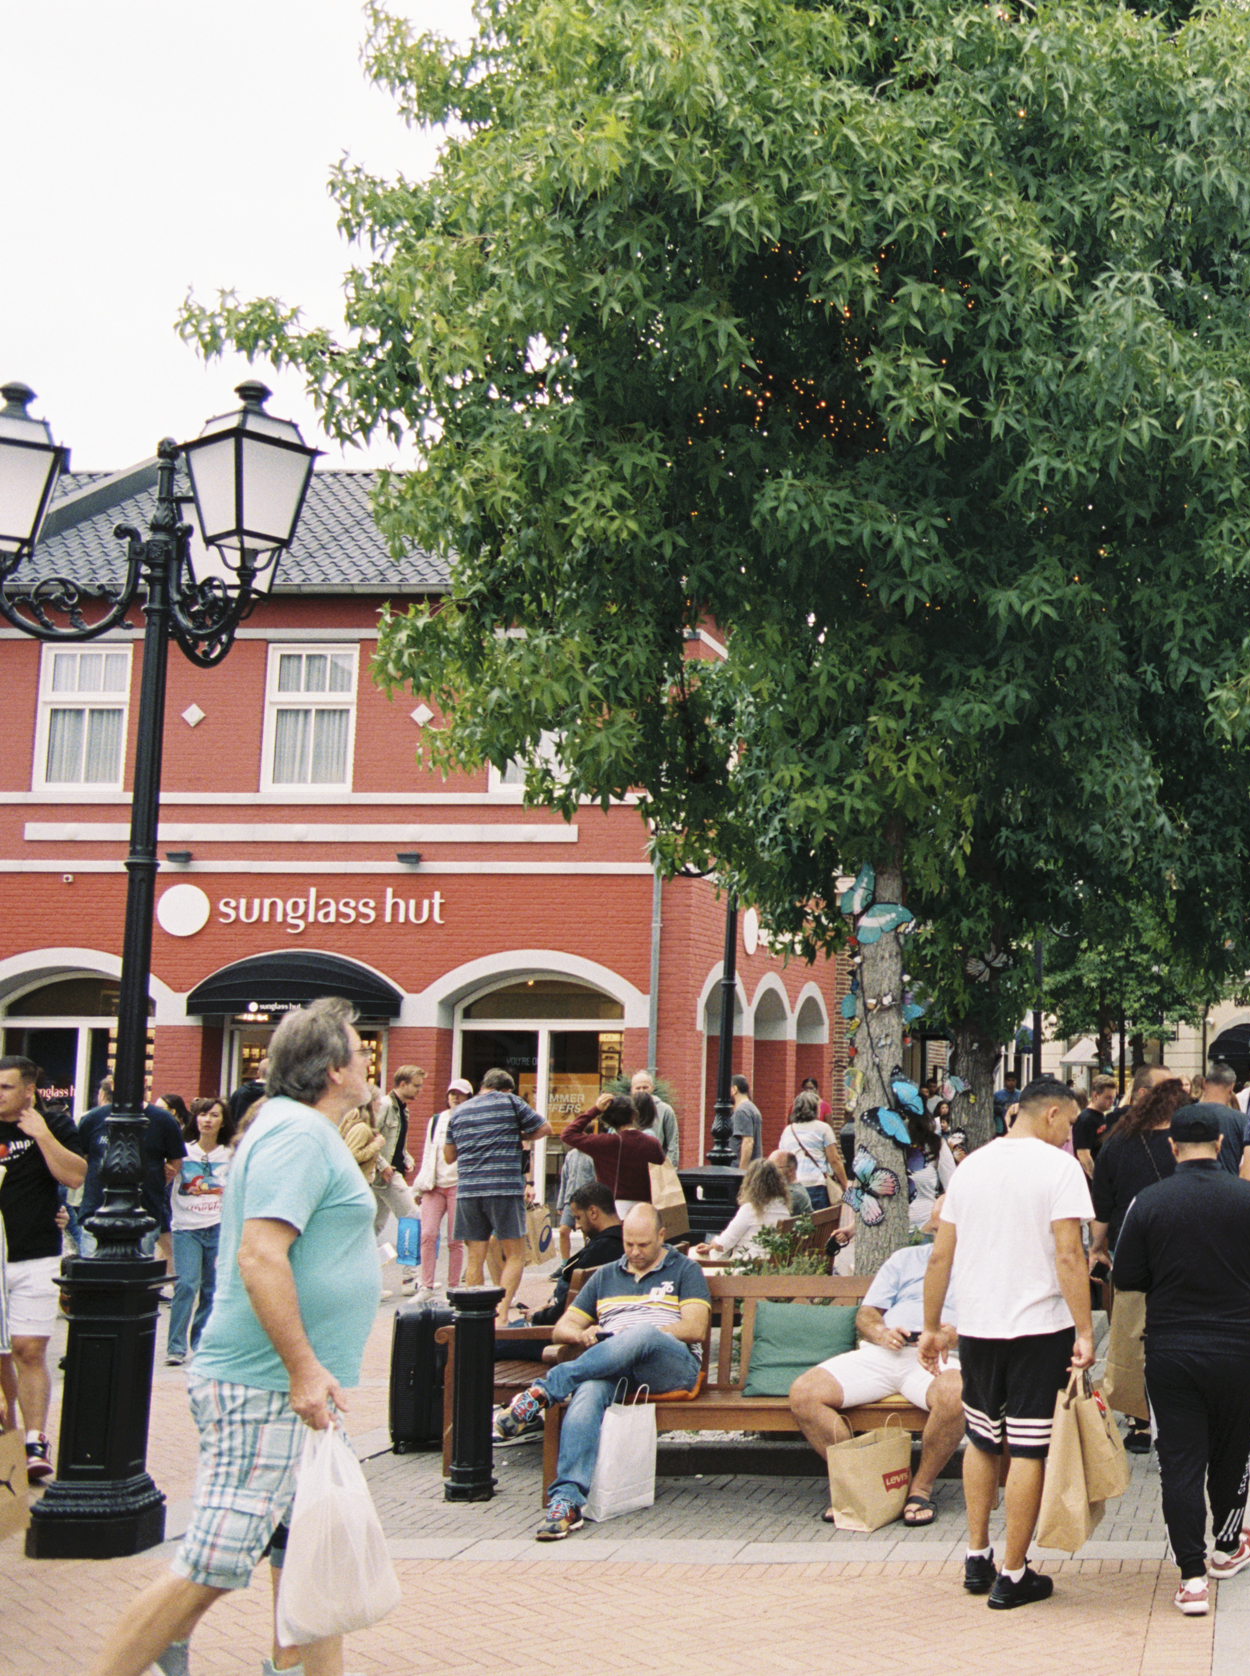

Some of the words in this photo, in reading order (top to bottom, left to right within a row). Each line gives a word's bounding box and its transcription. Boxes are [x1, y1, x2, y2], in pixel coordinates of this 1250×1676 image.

[218, 887, 376, 933] sunglass
[384, 887, 445, 924] hut
[259, 1002, 288, 1011] sunglass
[549, 1094, 585, 1103] MMER
